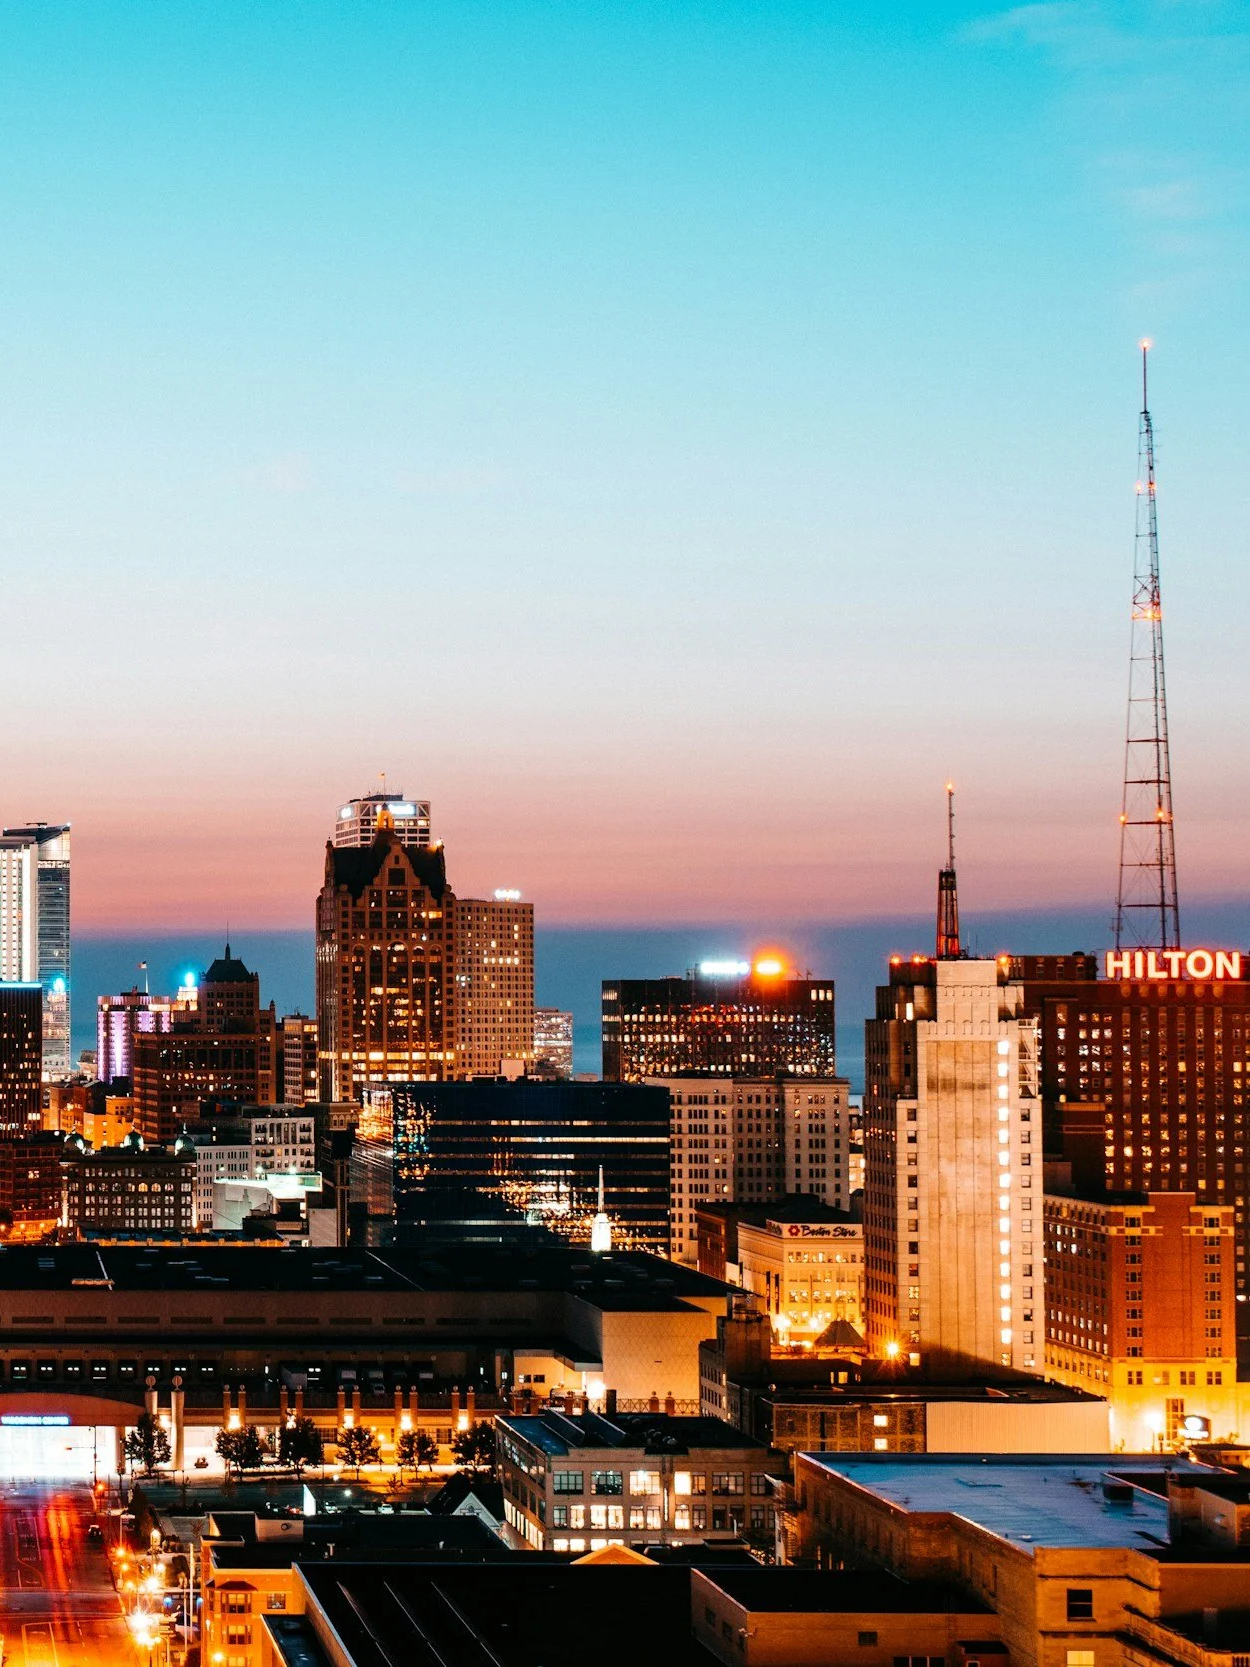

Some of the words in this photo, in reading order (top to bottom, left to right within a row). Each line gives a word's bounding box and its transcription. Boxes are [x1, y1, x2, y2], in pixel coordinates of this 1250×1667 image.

[1106, 950, 1240, 979] HILTON
[800, 1225, 831, 1237] Boston
[832, 1226, 858, 1237] Store
